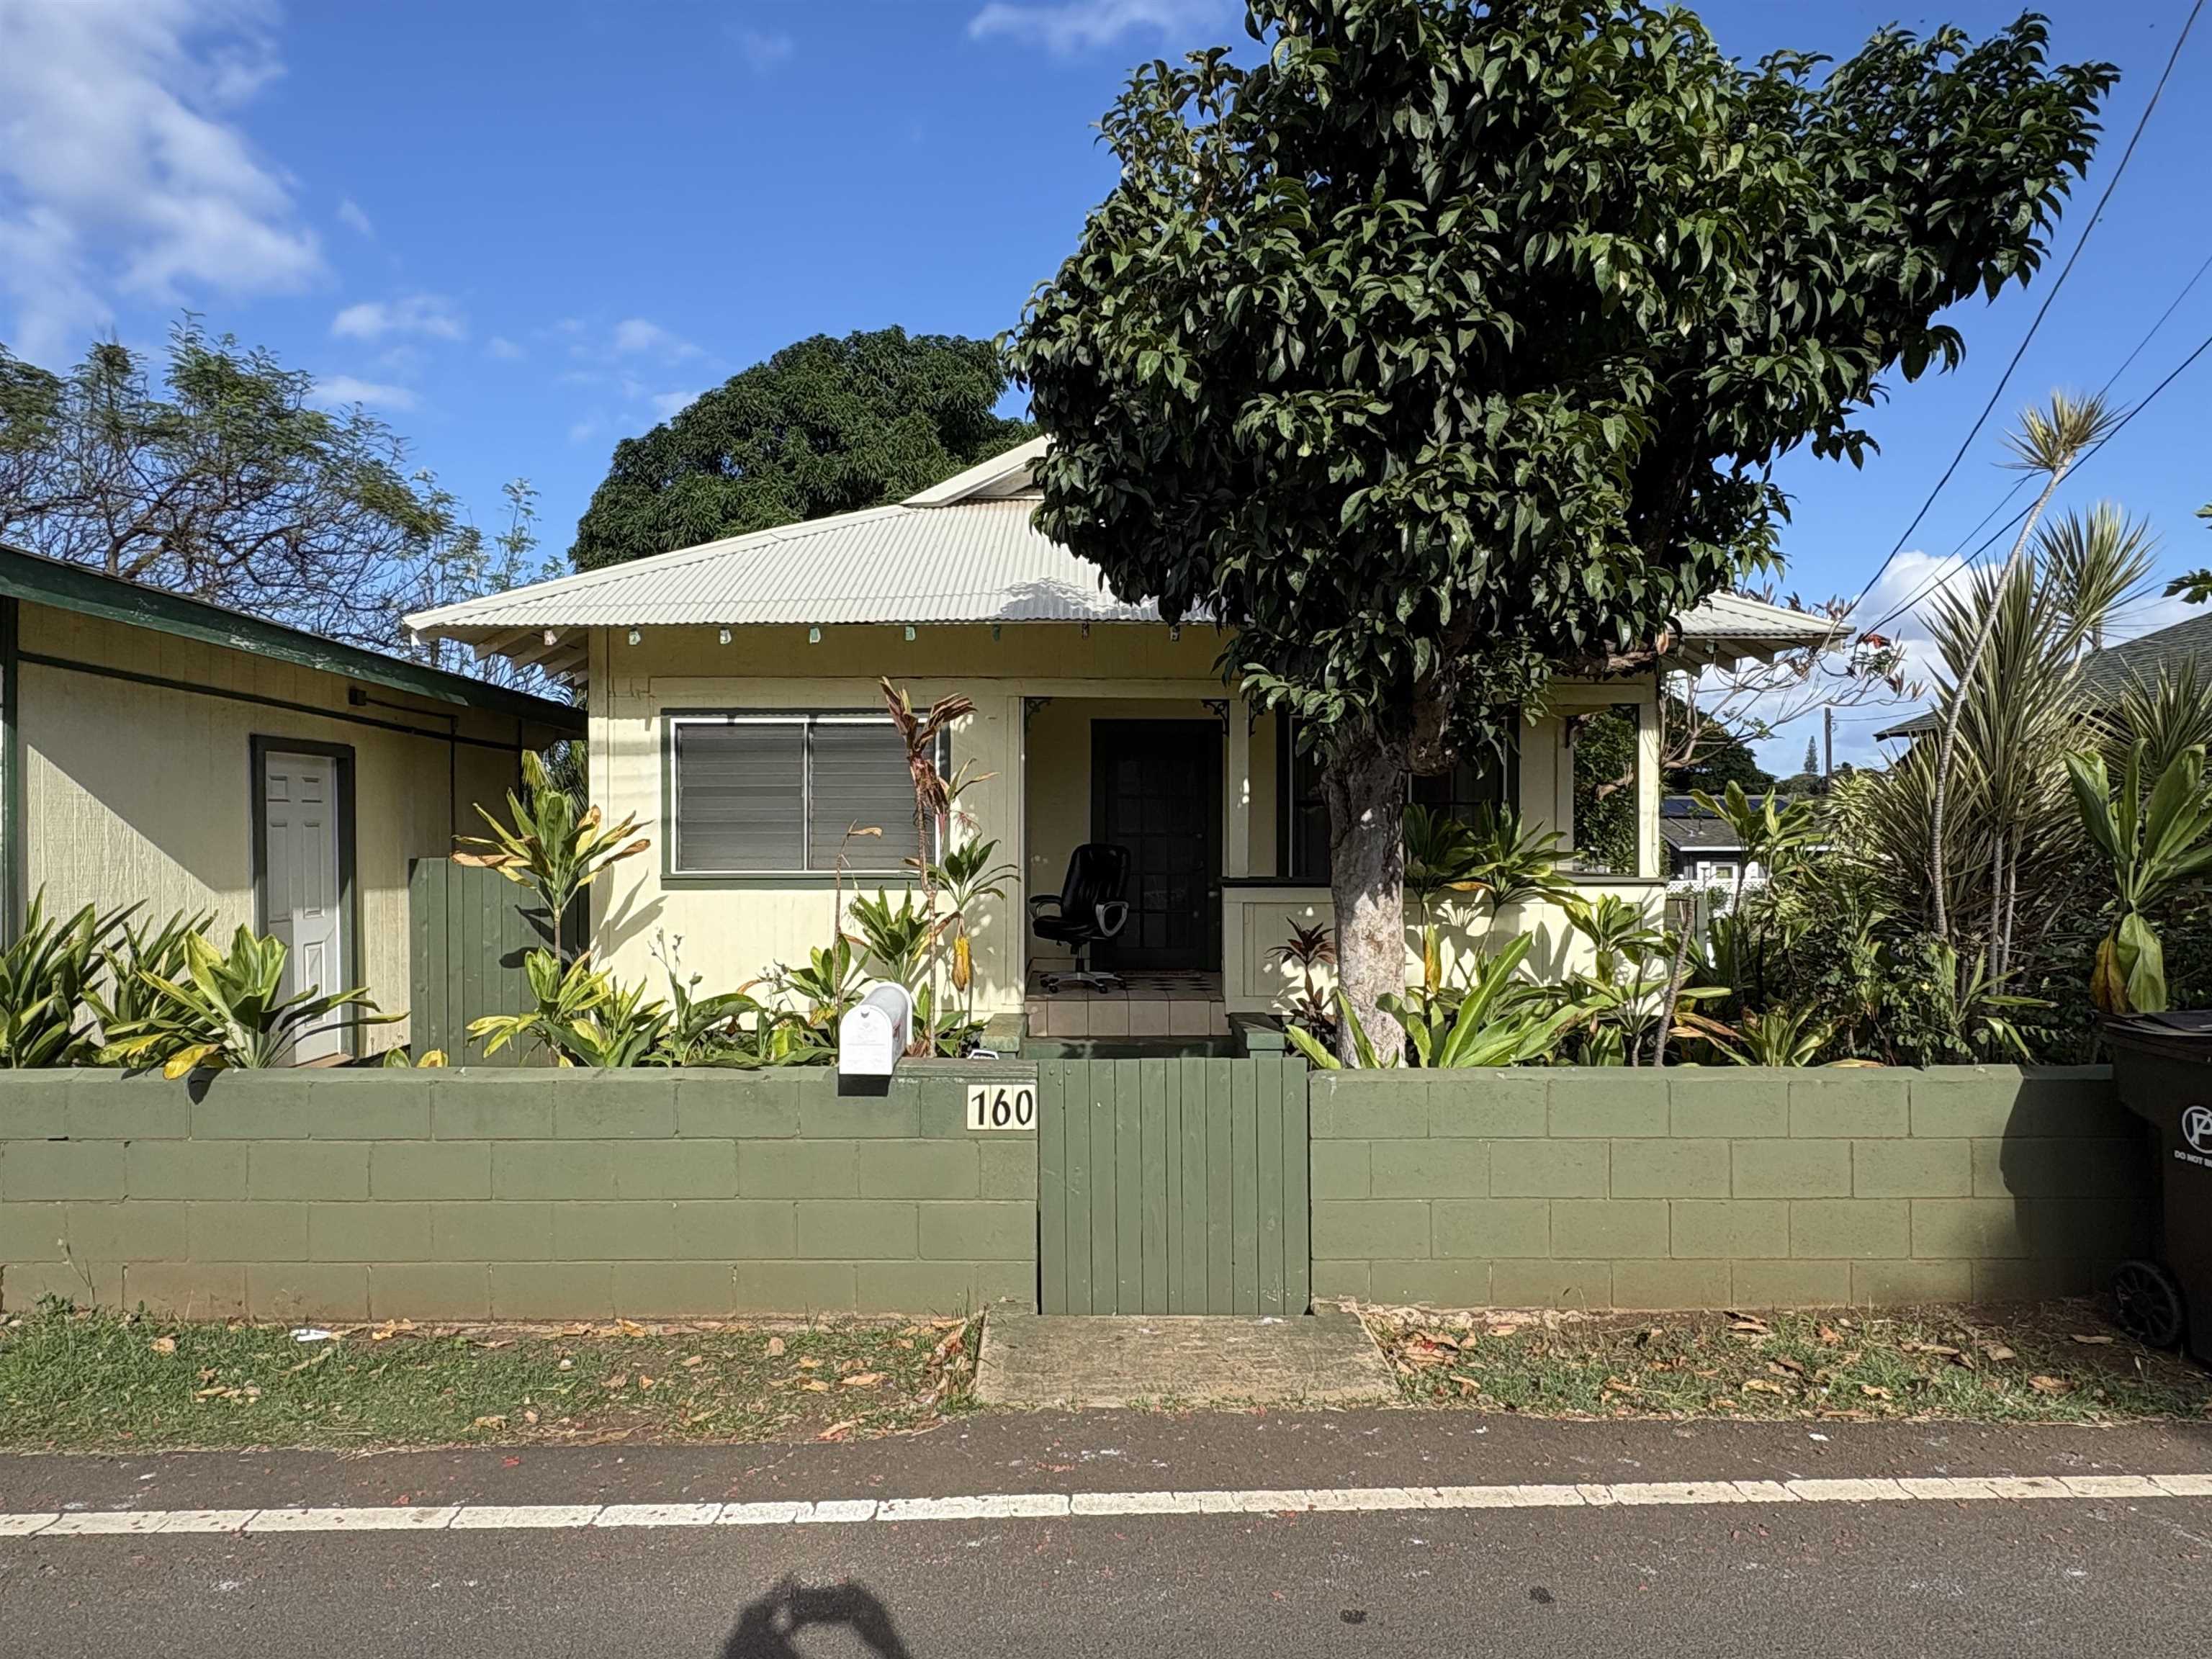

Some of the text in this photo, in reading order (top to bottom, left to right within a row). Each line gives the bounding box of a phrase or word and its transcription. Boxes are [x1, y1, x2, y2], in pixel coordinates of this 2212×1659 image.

[971, 1088, 1033, 1126] 160
[2174, 1150, 2186, 1160] DO
[2187, 1154, 2203, 1164] NOT
